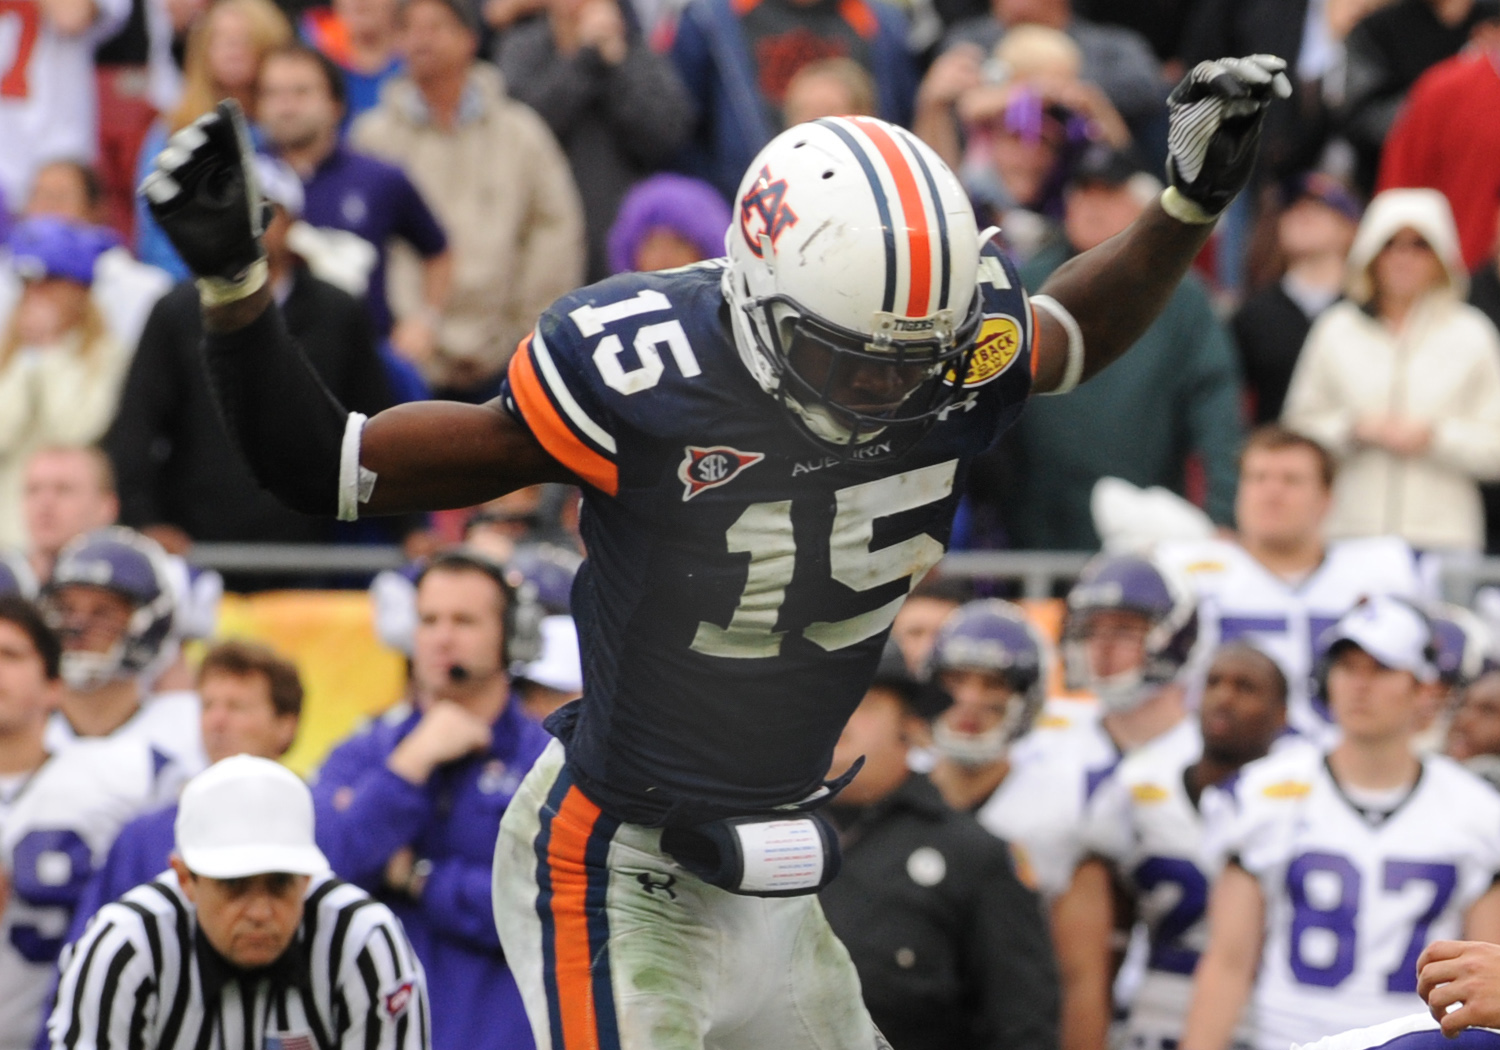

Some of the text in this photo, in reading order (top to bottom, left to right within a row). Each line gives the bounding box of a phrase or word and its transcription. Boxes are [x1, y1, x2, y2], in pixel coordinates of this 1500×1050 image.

[568, 289, 702, 395] 15
[893, 319, 935, 332] TIGERS
[971, 334, 1016, 367] TBACK
[697, 453, 728, 482] SEC
[688, 458, 960, 660] 15
[1286, 851, 1457, 994] 87
